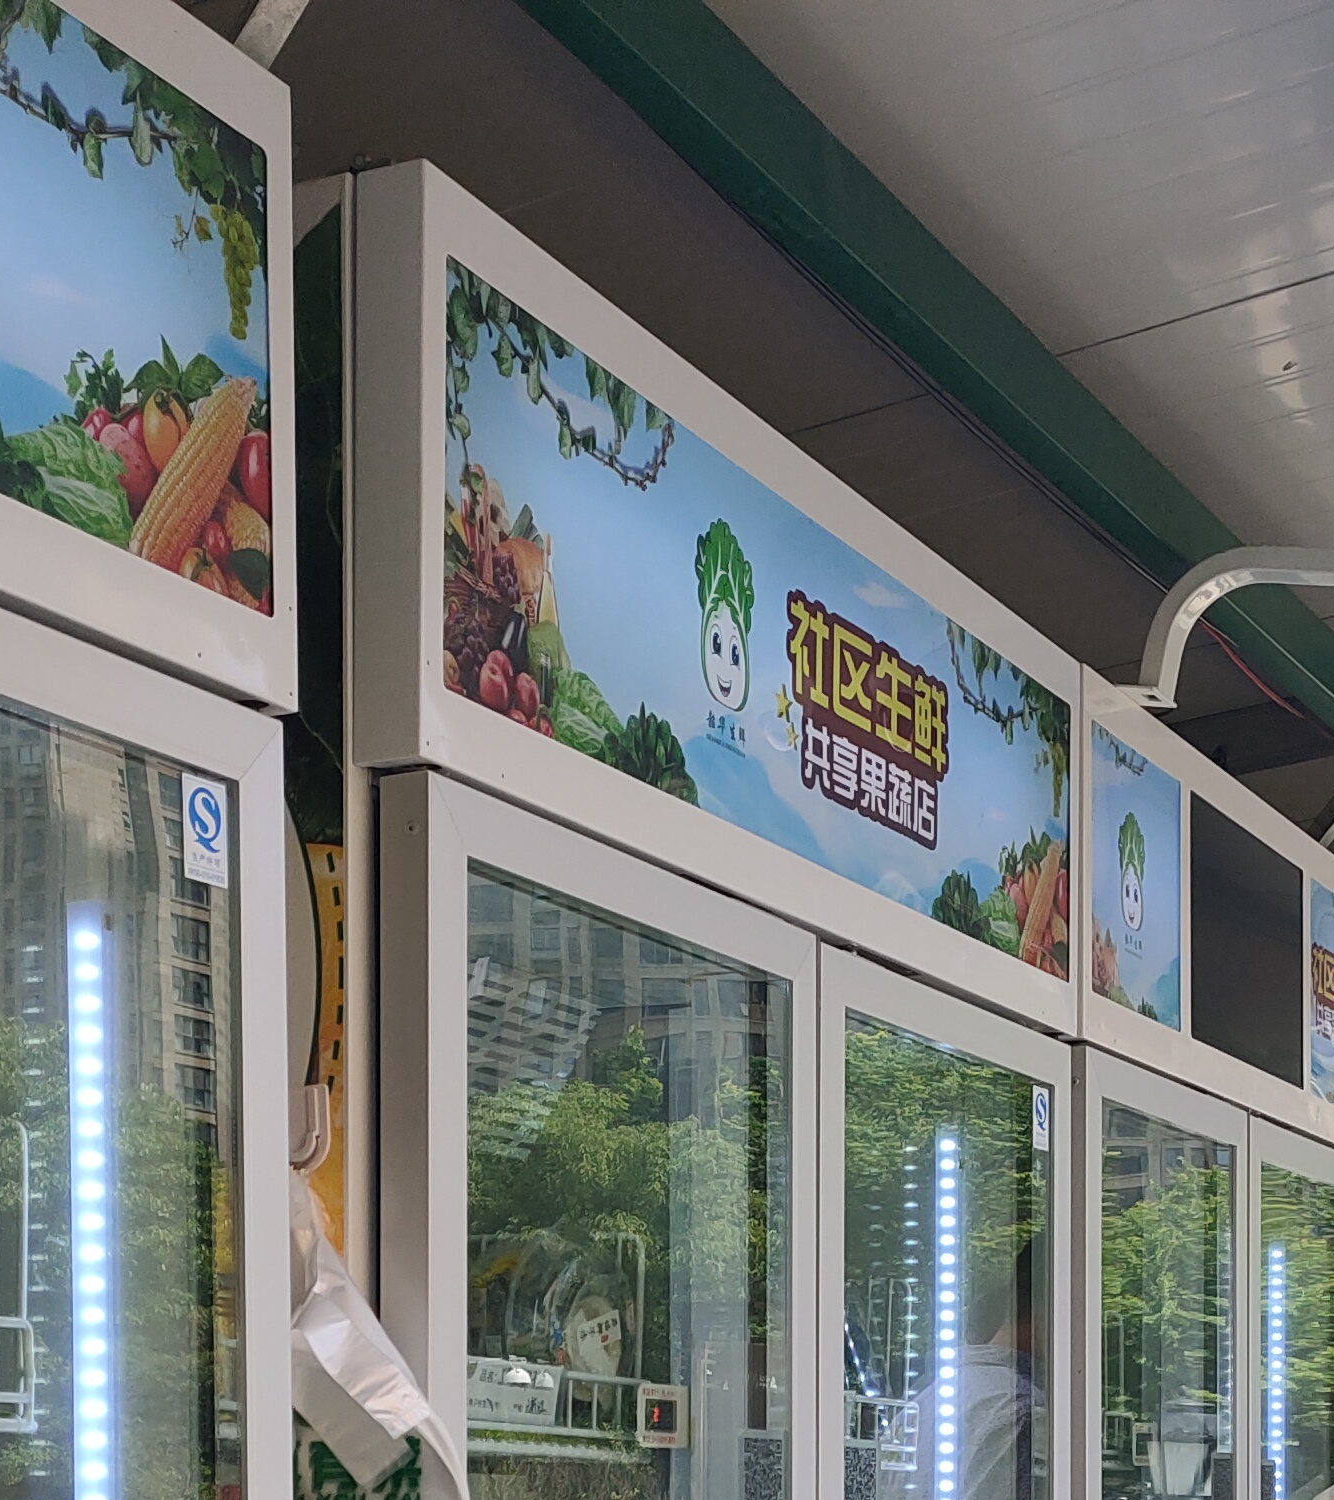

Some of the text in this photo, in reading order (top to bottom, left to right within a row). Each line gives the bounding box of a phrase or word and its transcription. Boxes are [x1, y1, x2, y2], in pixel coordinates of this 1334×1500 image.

[790, 600, 947, 774] 社区生鲜
[805, 718, 936, 842] 共享果蔬店
